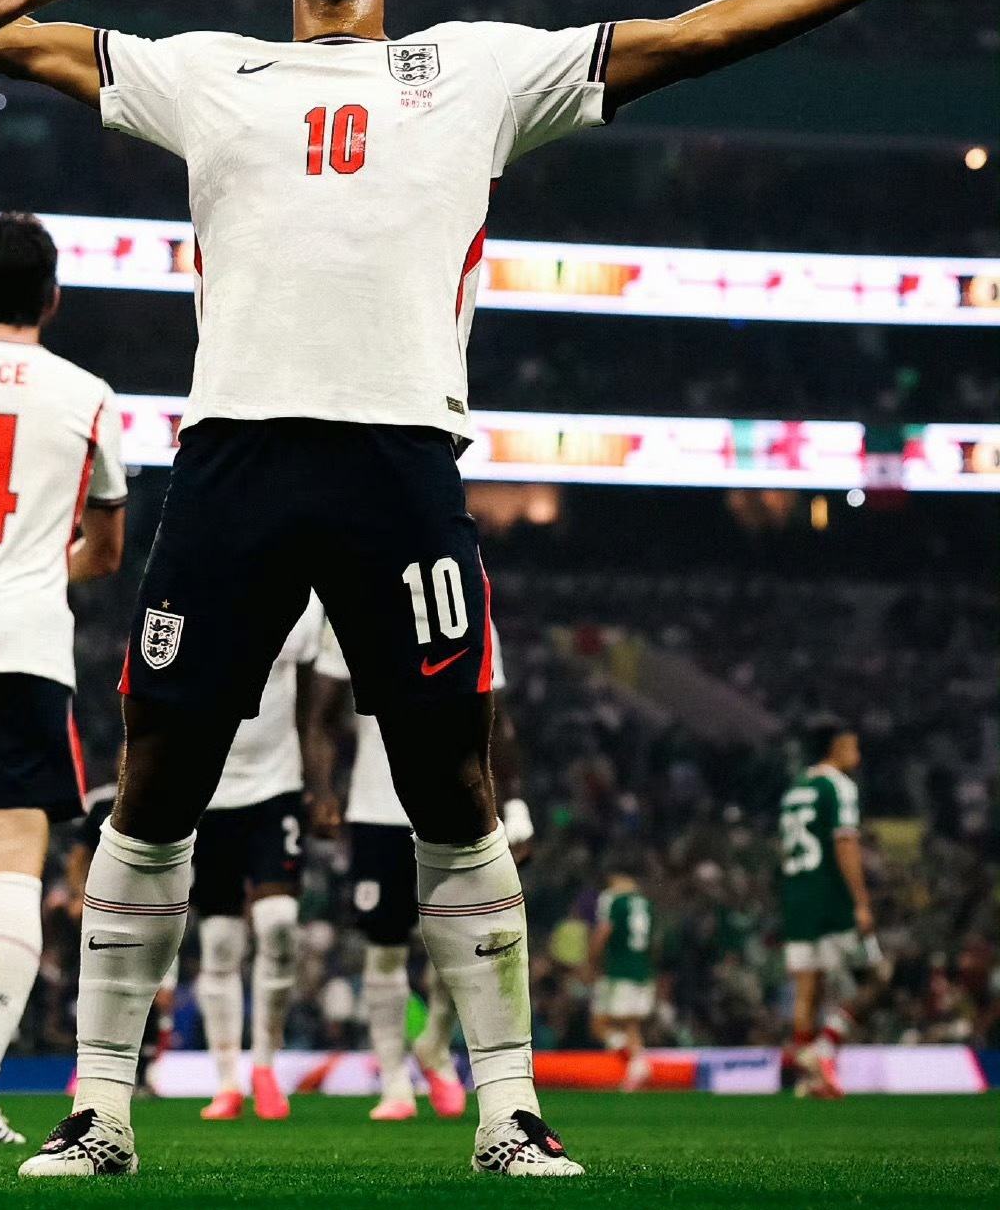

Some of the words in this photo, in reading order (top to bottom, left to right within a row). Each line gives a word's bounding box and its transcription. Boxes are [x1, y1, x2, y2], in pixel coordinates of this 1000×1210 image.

[305, 104, 369, 176] 10
[401, 556, 469, 645] 10
[281, 814, 302, 855] 2
